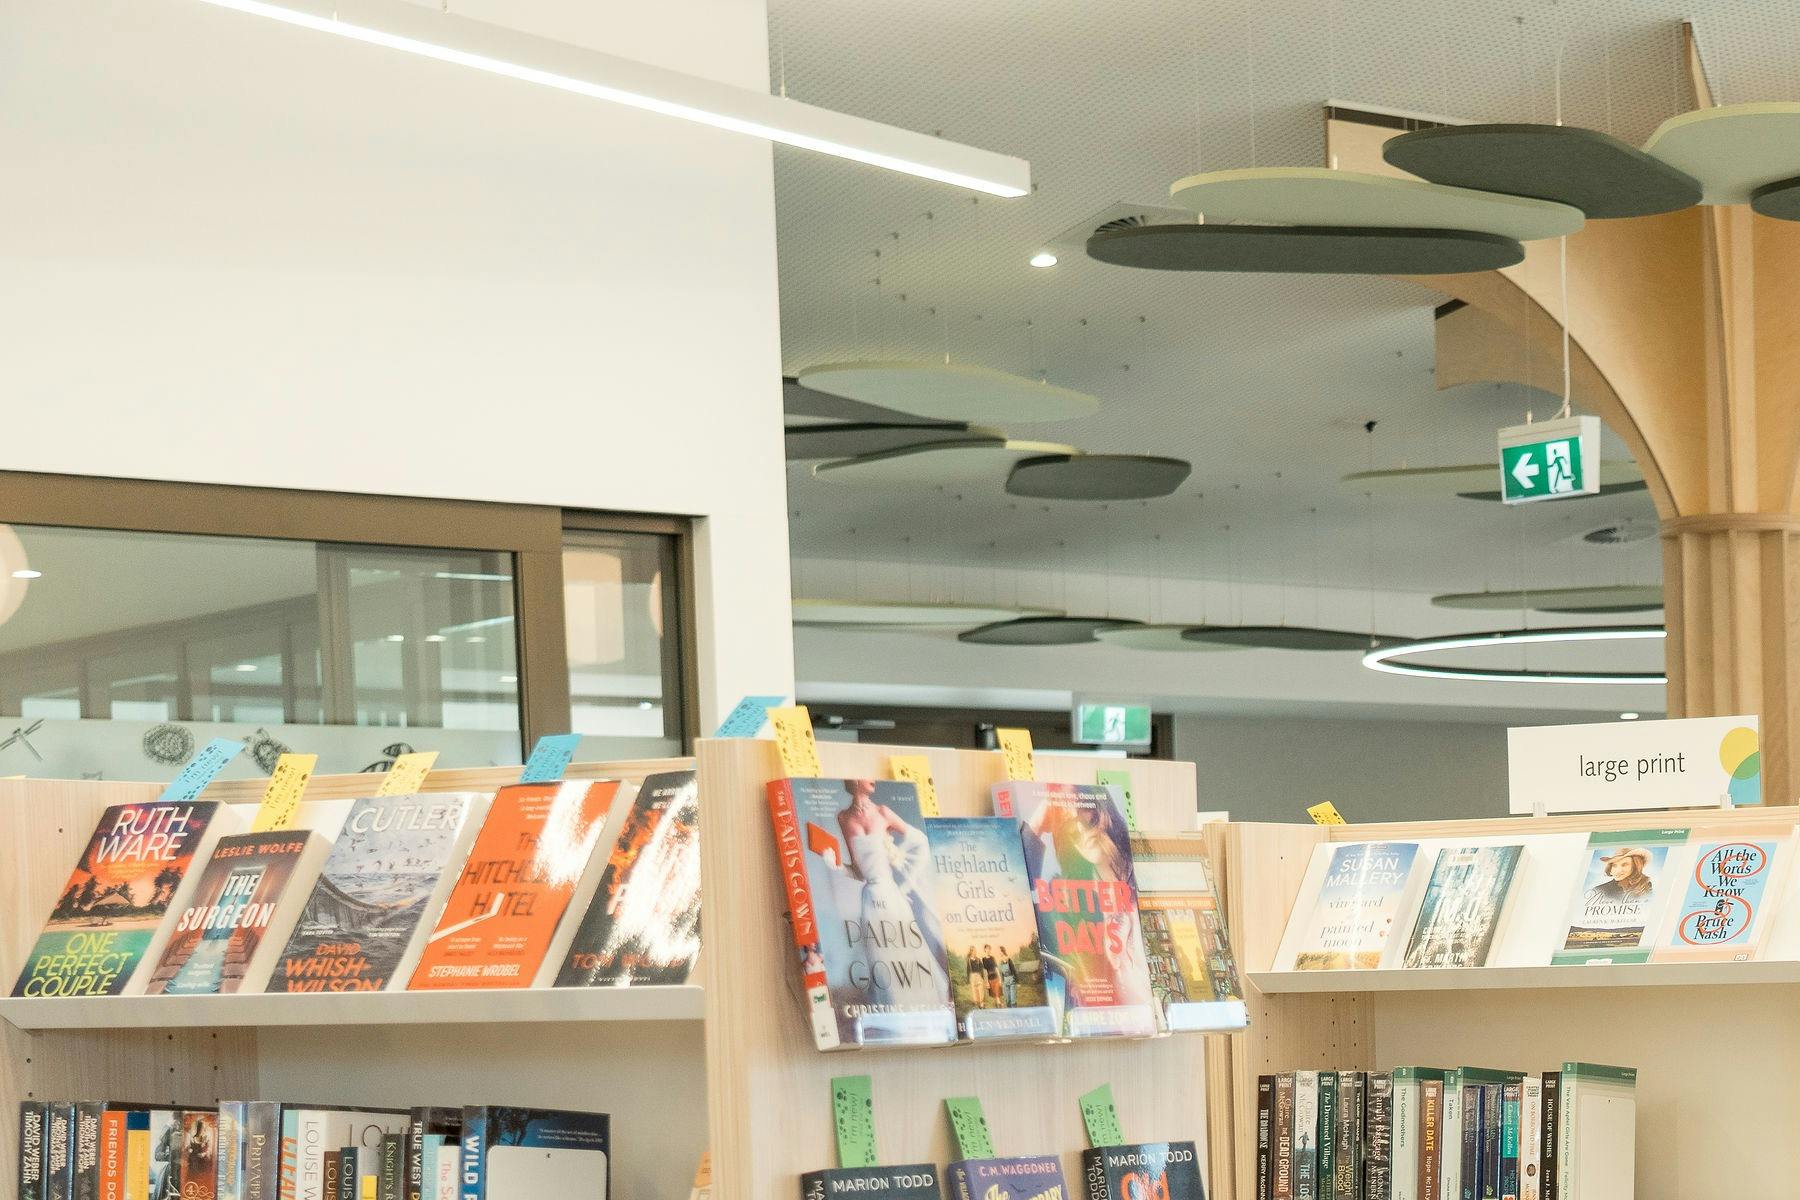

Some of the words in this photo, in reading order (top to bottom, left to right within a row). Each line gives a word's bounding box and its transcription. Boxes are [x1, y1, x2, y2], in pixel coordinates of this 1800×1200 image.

[1580, 754, 1629, 782] large
[1637, 752, 1685, 781] print
[111, 806, 192, 839] RUTH
[351, 805, 460, 834] CUTLER
[97, 833, 189, 865] WARE
[214, 844, 256, 861] LESLIE
[258, 841, 305, 857] WOLFE
[959, 840, 977, 854] The
[1711, 848, 1734, 862] All
[1734, 847, 1758, 862] the
[936, 854, 1010, 880] Highland
[1710, 861, 1752, 876] Words
[226, 872, 259, 898] THE
[957, 880, 995, 900] Girls
[1703, 885, 1745, 898] Know
[1718, 875, 1738, 888] We
[1034, 879, 1137, 914] BETTER
[177, 901, 278, 934] SURGEON
[946, 911, 962, 924] on
[964, 903, 1016, 924] Guard
[1696, 914, 1735, 928] Bruce
[65, 932, 118, 957] ONE
[845, 919, 924, 949] PARIS
[1055, 919, 1124, 955] DAYS
[1693, 926, 1728, 941] Nash
[315, 942, 362, 958] DAVID
[32, 951, 134, 979] PERFECT
[284, 954, 373, 978] WHISH-
[429, 963, 482, 979] STEPHANIE
[483, 962, 521, 977] WROBEL
[849, 960, 935, 991] GOWN
[23, 974, 118, 998] COUPLE
[847, 1092, 857, 1122] new!
[107, 1118, 119, 1180] FRIENDS
[304, 1120, 320, 1184] LOUISE
[462, 1134, 481, 1185] WILD
[1108, 1152, 1158, 1168] MARION
[1158, 1149, 1193, 1163] TODD
[978, 1165, 1004, 1179] C.M.
[1003, 1162, 1058, 1177] WAGGONER
[1086, 1166, 1100, 1200] TODD
[831, 1176, 890, 1194] MARION
[894, 1173, 935, 1189] TODD
